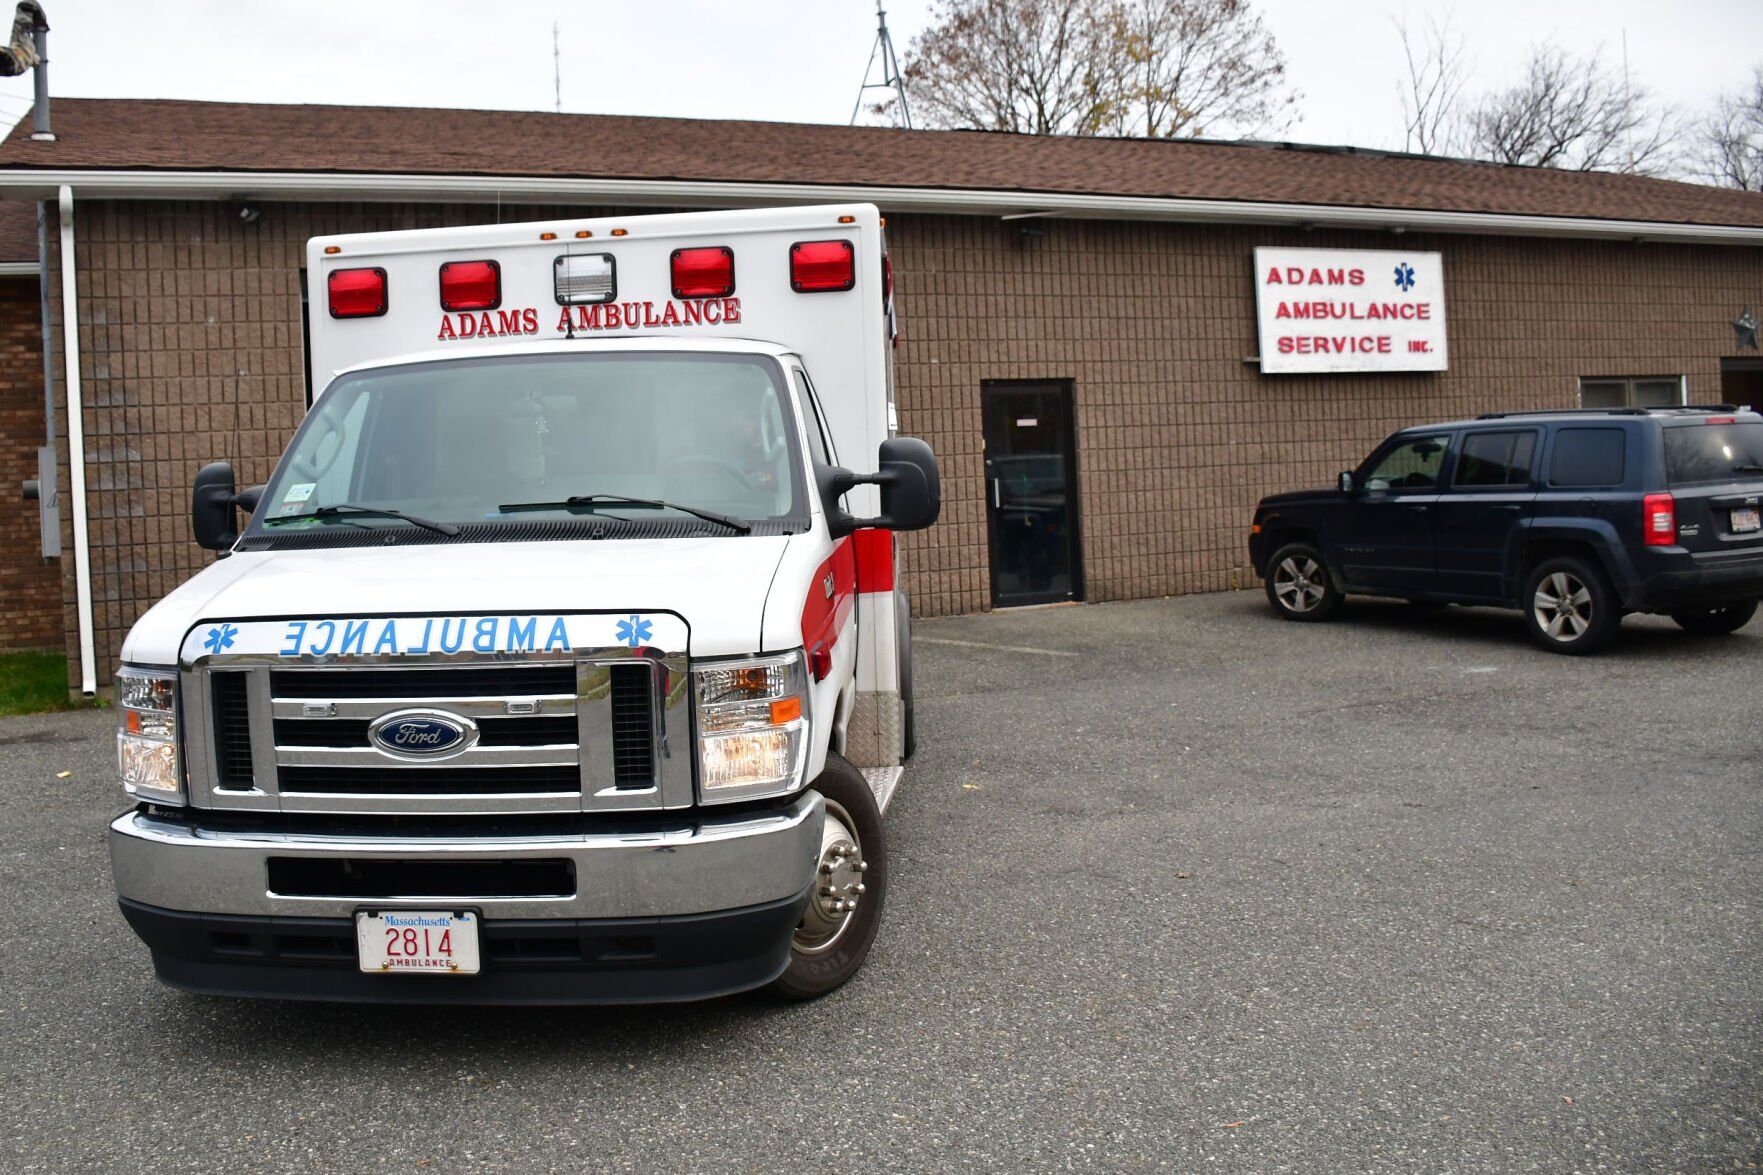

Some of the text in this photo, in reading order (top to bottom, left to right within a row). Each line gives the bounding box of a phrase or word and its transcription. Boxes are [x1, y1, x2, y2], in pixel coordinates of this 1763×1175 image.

[1266, 267, 1365, 285] ADAMS
[437, 297, 742, 340] ADAMS AMBULANCE
[1275, 302, 1431, 320] AMBULANCE
[1277, 336, 1392, 354] SERVICE
[395, 723, 442, 744] Ford
[384, 915, 451, 927] Massachusetts
[385, 928, 452, 957] 2814
[389, 959, 451, 968] AMBULANCE
